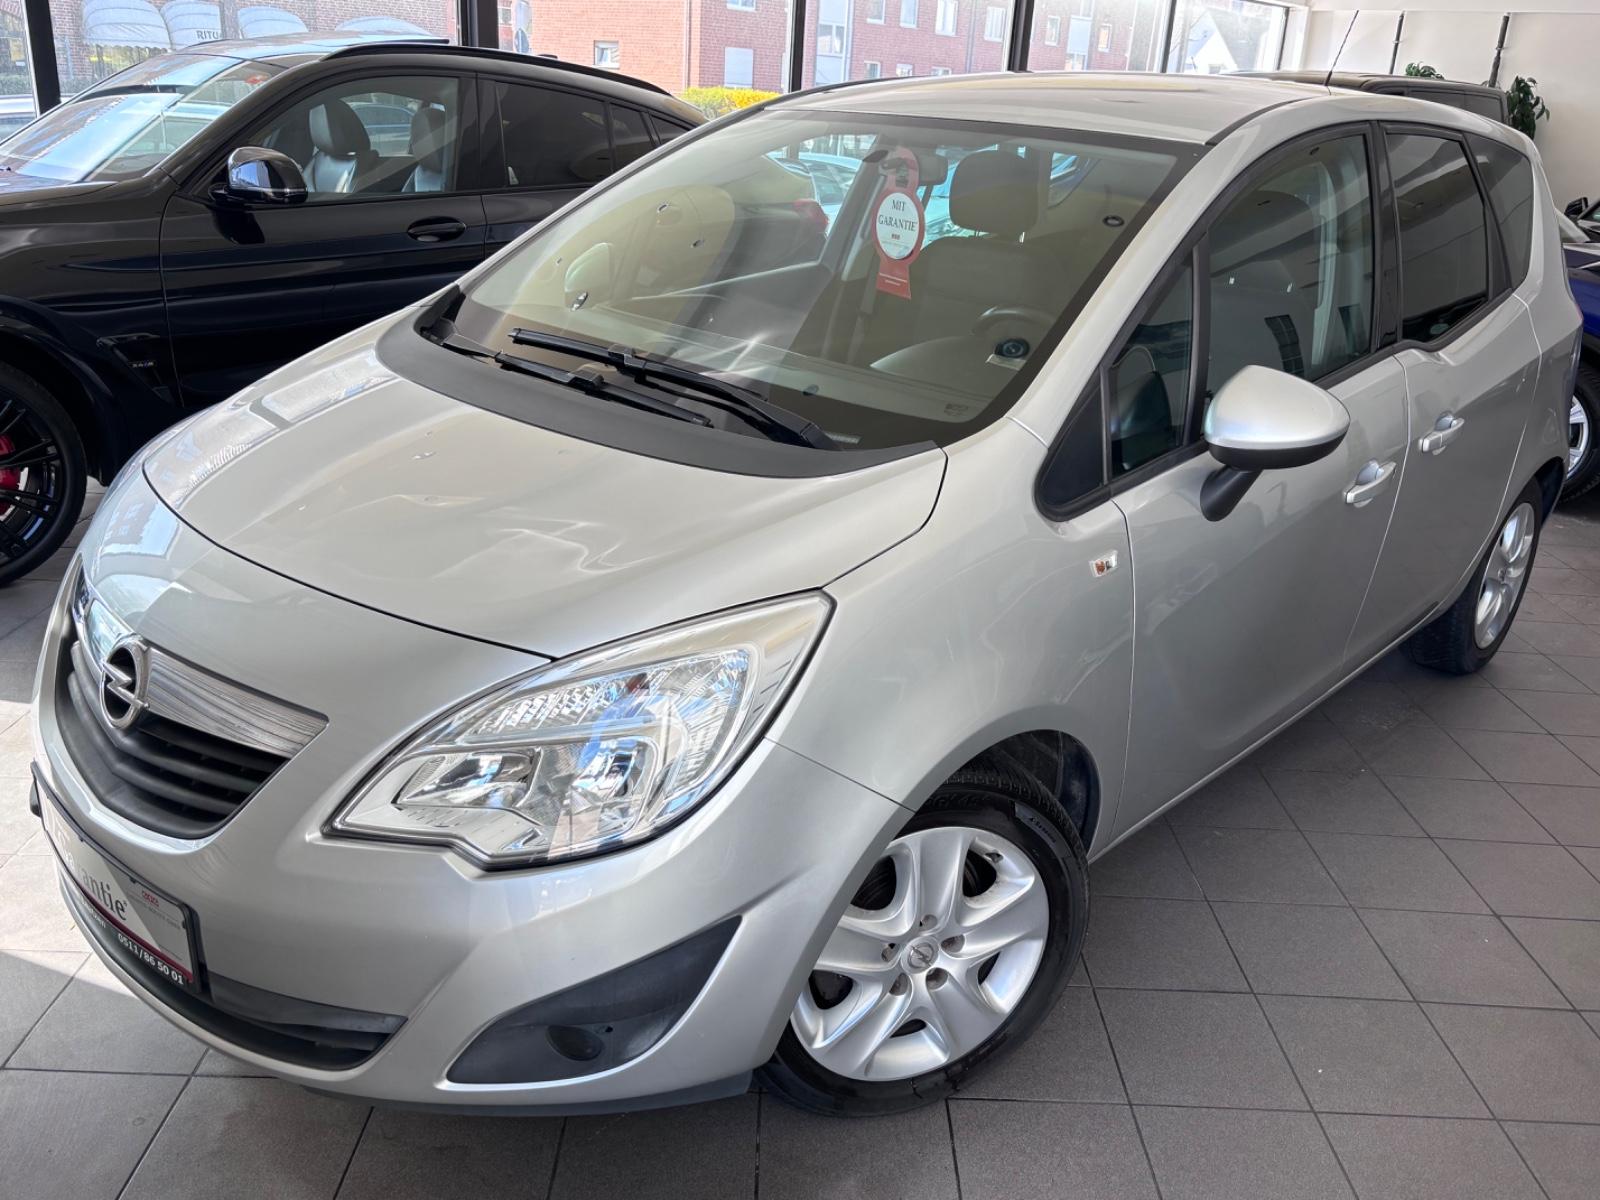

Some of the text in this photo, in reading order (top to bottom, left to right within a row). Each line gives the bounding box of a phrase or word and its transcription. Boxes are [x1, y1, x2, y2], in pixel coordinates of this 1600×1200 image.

[891, 199, 906, 212] MIT
[878, 214, 916, 232] GARANTIE
[157, 960, 170, 976] 50
[171, 969, 184, 985] 01
